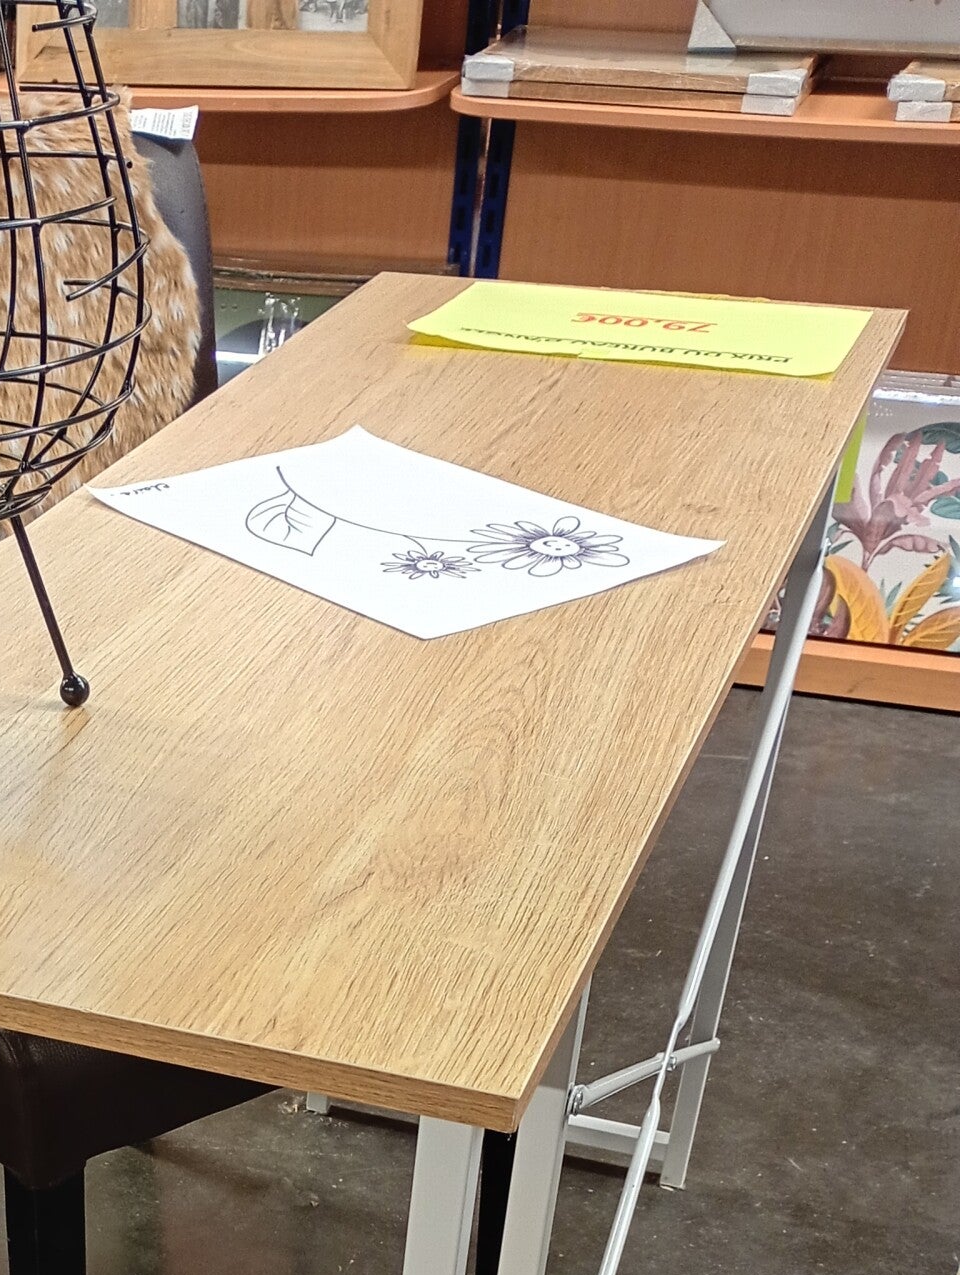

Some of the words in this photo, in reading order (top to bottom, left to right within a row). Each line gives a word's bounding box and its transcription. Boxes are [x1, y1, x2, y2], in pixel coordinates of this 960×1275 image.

[571, 339, 676, 354] BUREAU
[684, 348, 722, 358] DU
[731, 352, 791, 364] PRIX
